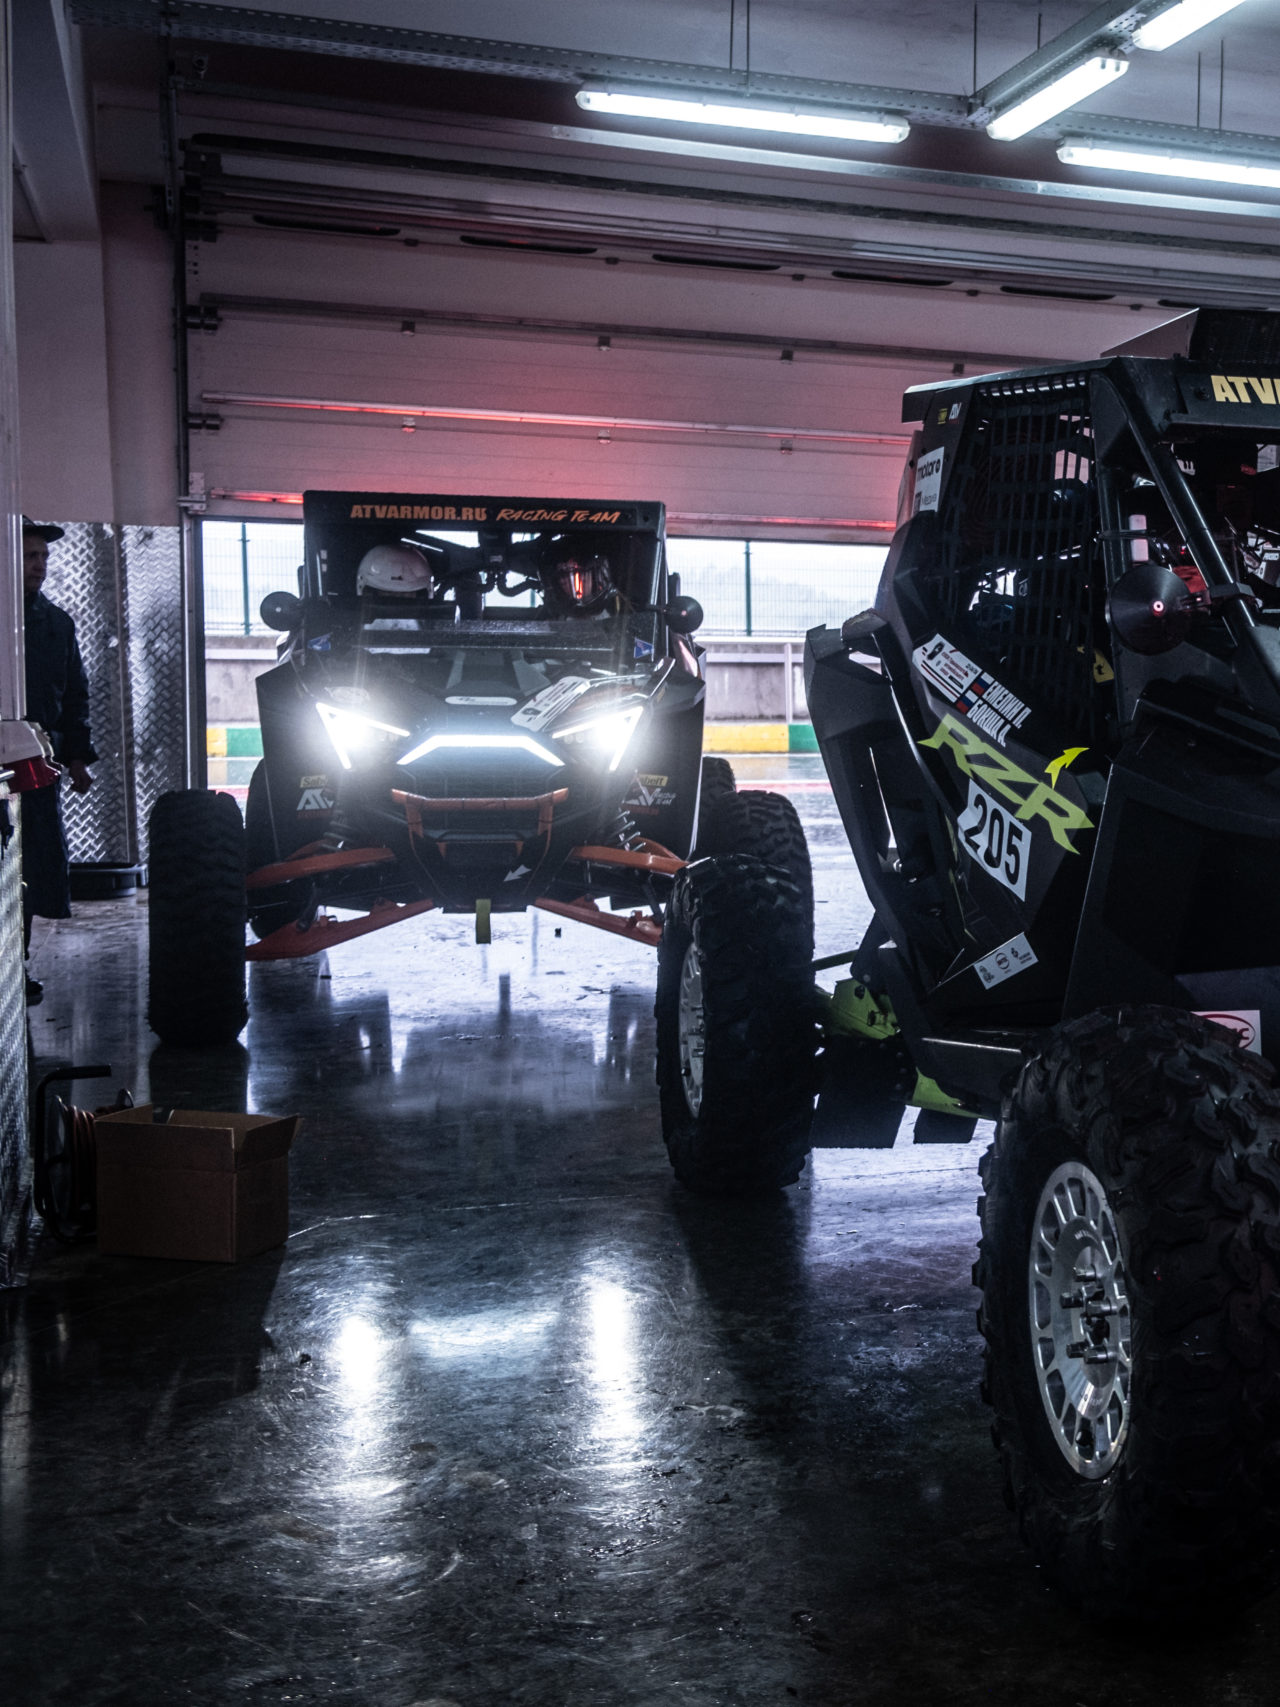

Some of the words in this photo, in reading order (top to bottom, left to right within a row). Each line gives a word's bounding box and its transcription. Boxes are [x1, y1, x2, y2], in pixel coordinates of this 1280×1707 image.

[350, 504, 488, 522] ATVARMOR.RU
[497, 508, 568, 523] RACING
[570, 510, 621, 524] TEAM
[982, 680, 1026, 721] ЕМЕЛИН
[917, 713, 1095, 855] RZR
[963, 794, 1023, 886] 205
